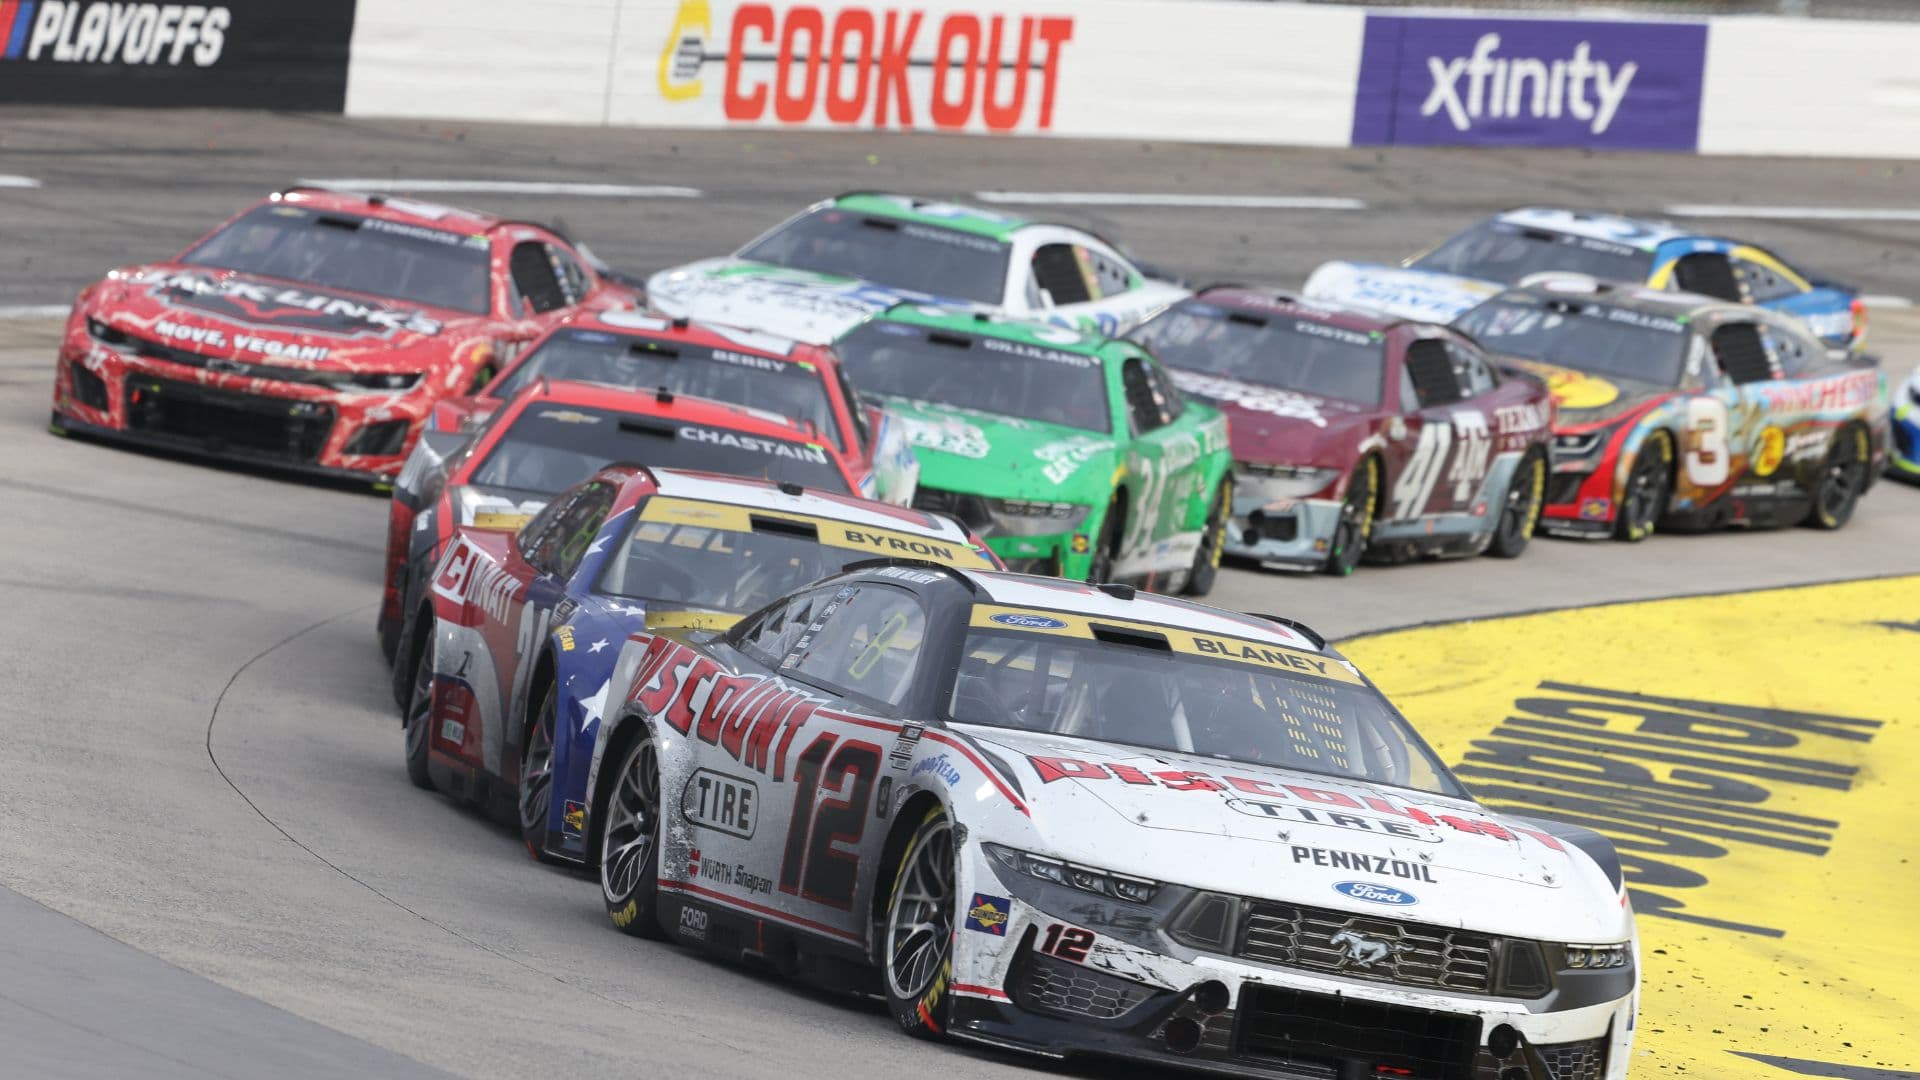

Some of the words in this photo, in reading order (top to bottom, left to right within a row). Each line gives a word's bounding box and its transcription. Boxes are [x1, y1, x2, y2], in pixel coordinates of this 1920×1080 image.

[28, 1, 231, 66] PLAYOFFS
[723, 3, 923, 128] COOK
[930, 13, 1074, 132] OUT
[1422, 33, 1637, 133] xfinity
[155, 320, 227, 348] MOVE,
[234, 335, 330, 361] VEGAN!
[1296, 321, 1370, 346] CUSTER
[1607, 309, 1684, 333] DILLON
[712, 350, 786, 372] BERRY
[983, 338, 1091, 369] GILLILAND
[679, 426, 828, 465] CHASTAIN
[1686, 397, 1730, 486] 3
[1393, 422, 1451, 521] 41
[845, 530, 954, 560] BYRON
[1002, 612, 1061, 629] Ford
[1191, 637, 1328, 675] BLANEY
[628, 635, 824, 783] DISCOUNT
[698, 776, 753, 831] TIRE
[778, 731, 883, 913] 12
[1027, 755, 1568, 852] DISCOUNT
[1247, 801, 1421, 838] TIRE
[1291, 845, 1438, 884] PENNZOIL
[1349, 883, 1405, 905] Ford
[680, 906, 708, 930] FORD
[969, 907, 1009, 924] SUNOCO
[1040, 923, 1096, 963] 12
